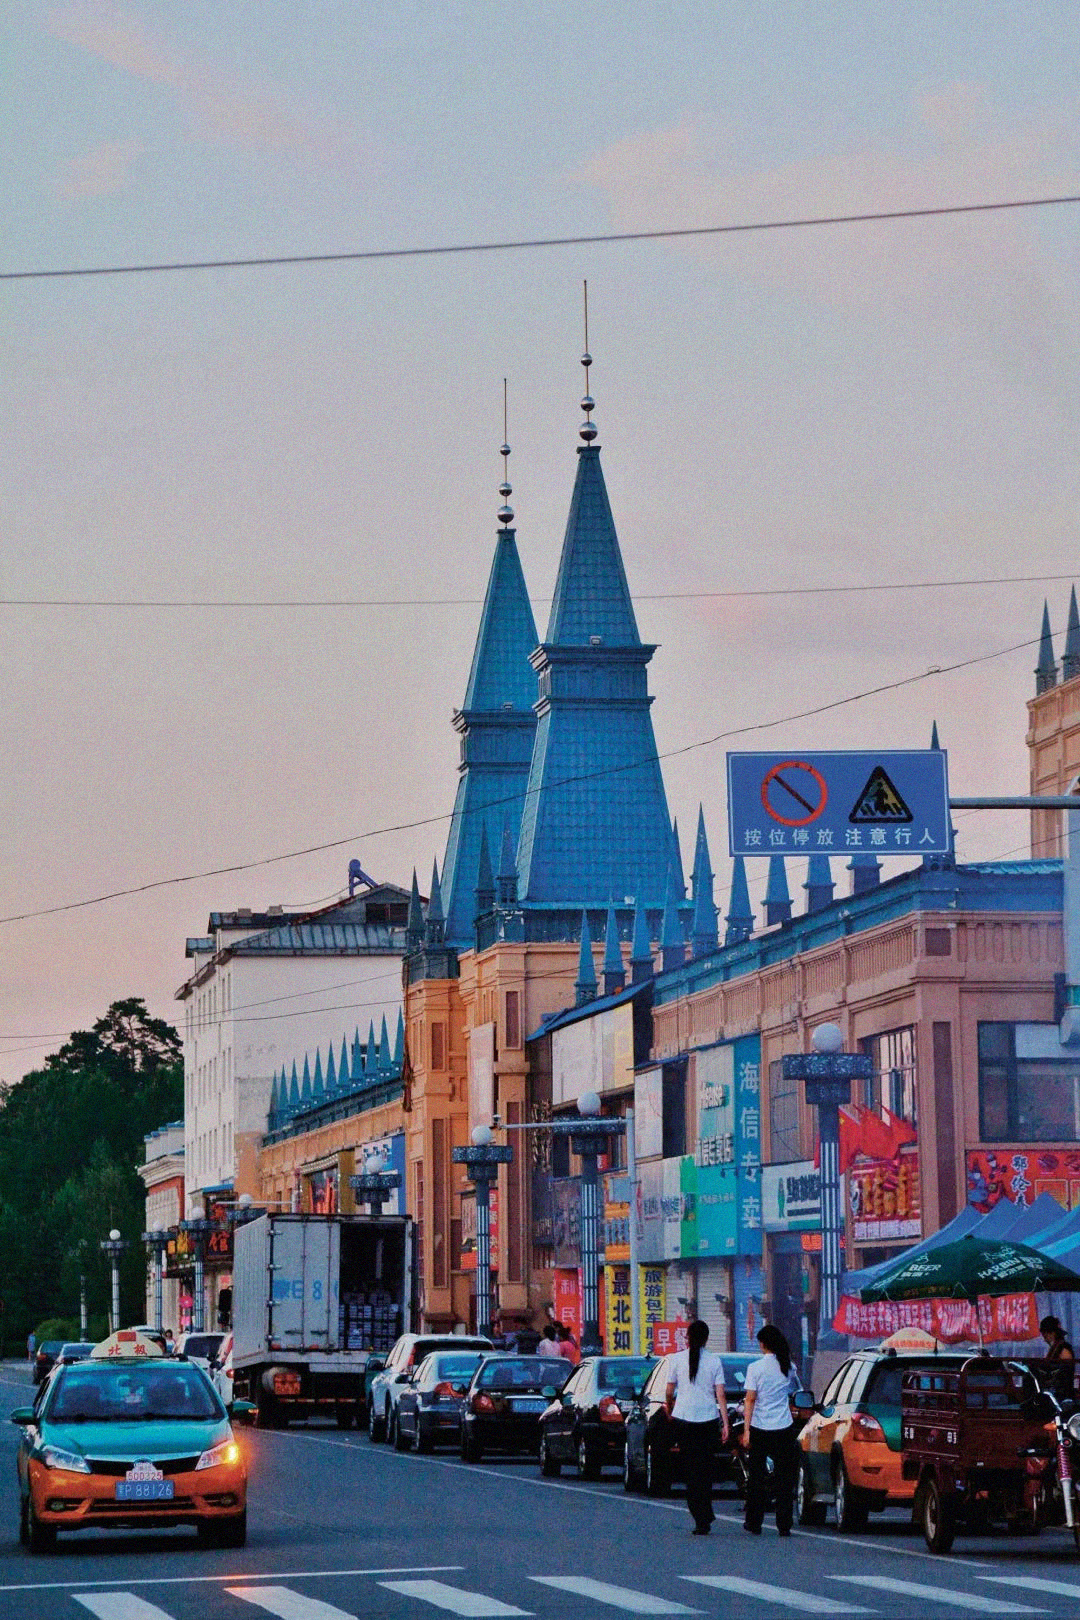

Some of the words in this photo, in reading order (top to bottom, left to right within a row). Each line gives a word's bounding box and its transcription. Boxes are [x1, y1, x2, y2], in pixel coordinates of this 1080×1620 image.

[739, 1062, 760, 1229] 海信专卖
[908, 1263, 941, 1272] BEER
